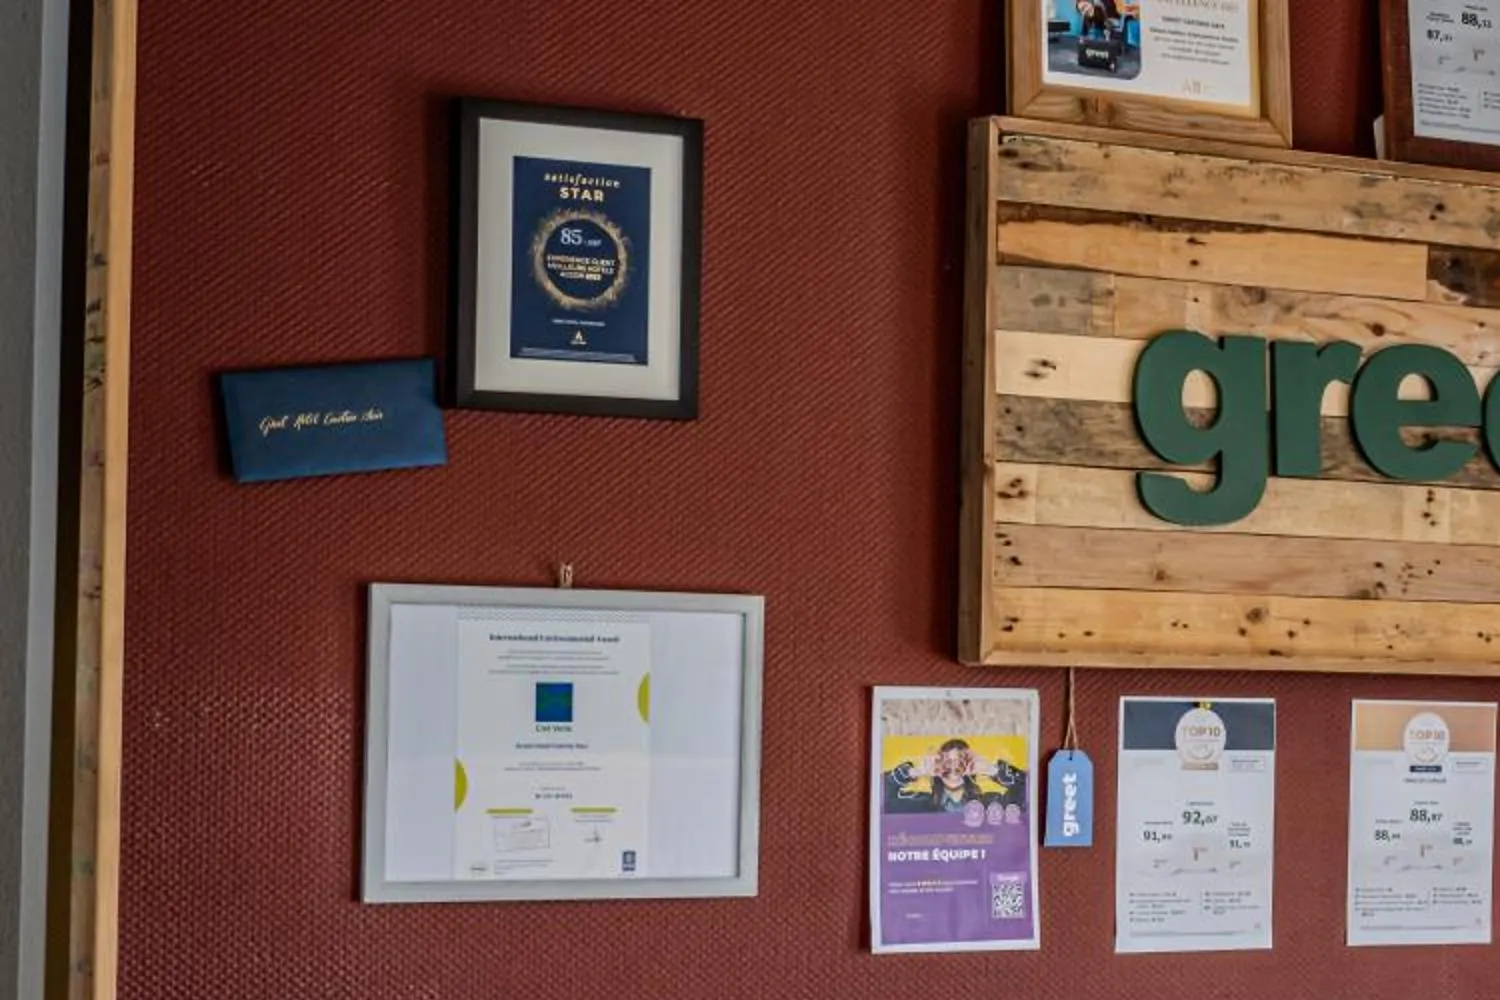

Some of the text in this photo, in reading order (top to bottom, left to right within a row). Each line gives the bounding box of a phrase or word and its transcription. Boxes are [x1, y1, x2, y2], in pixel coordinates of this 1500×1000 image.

[559, 187, 604, 202] STAR
[1061, 772, 1080, 837] greet
[887, 849, 929, 861] NOTRE
